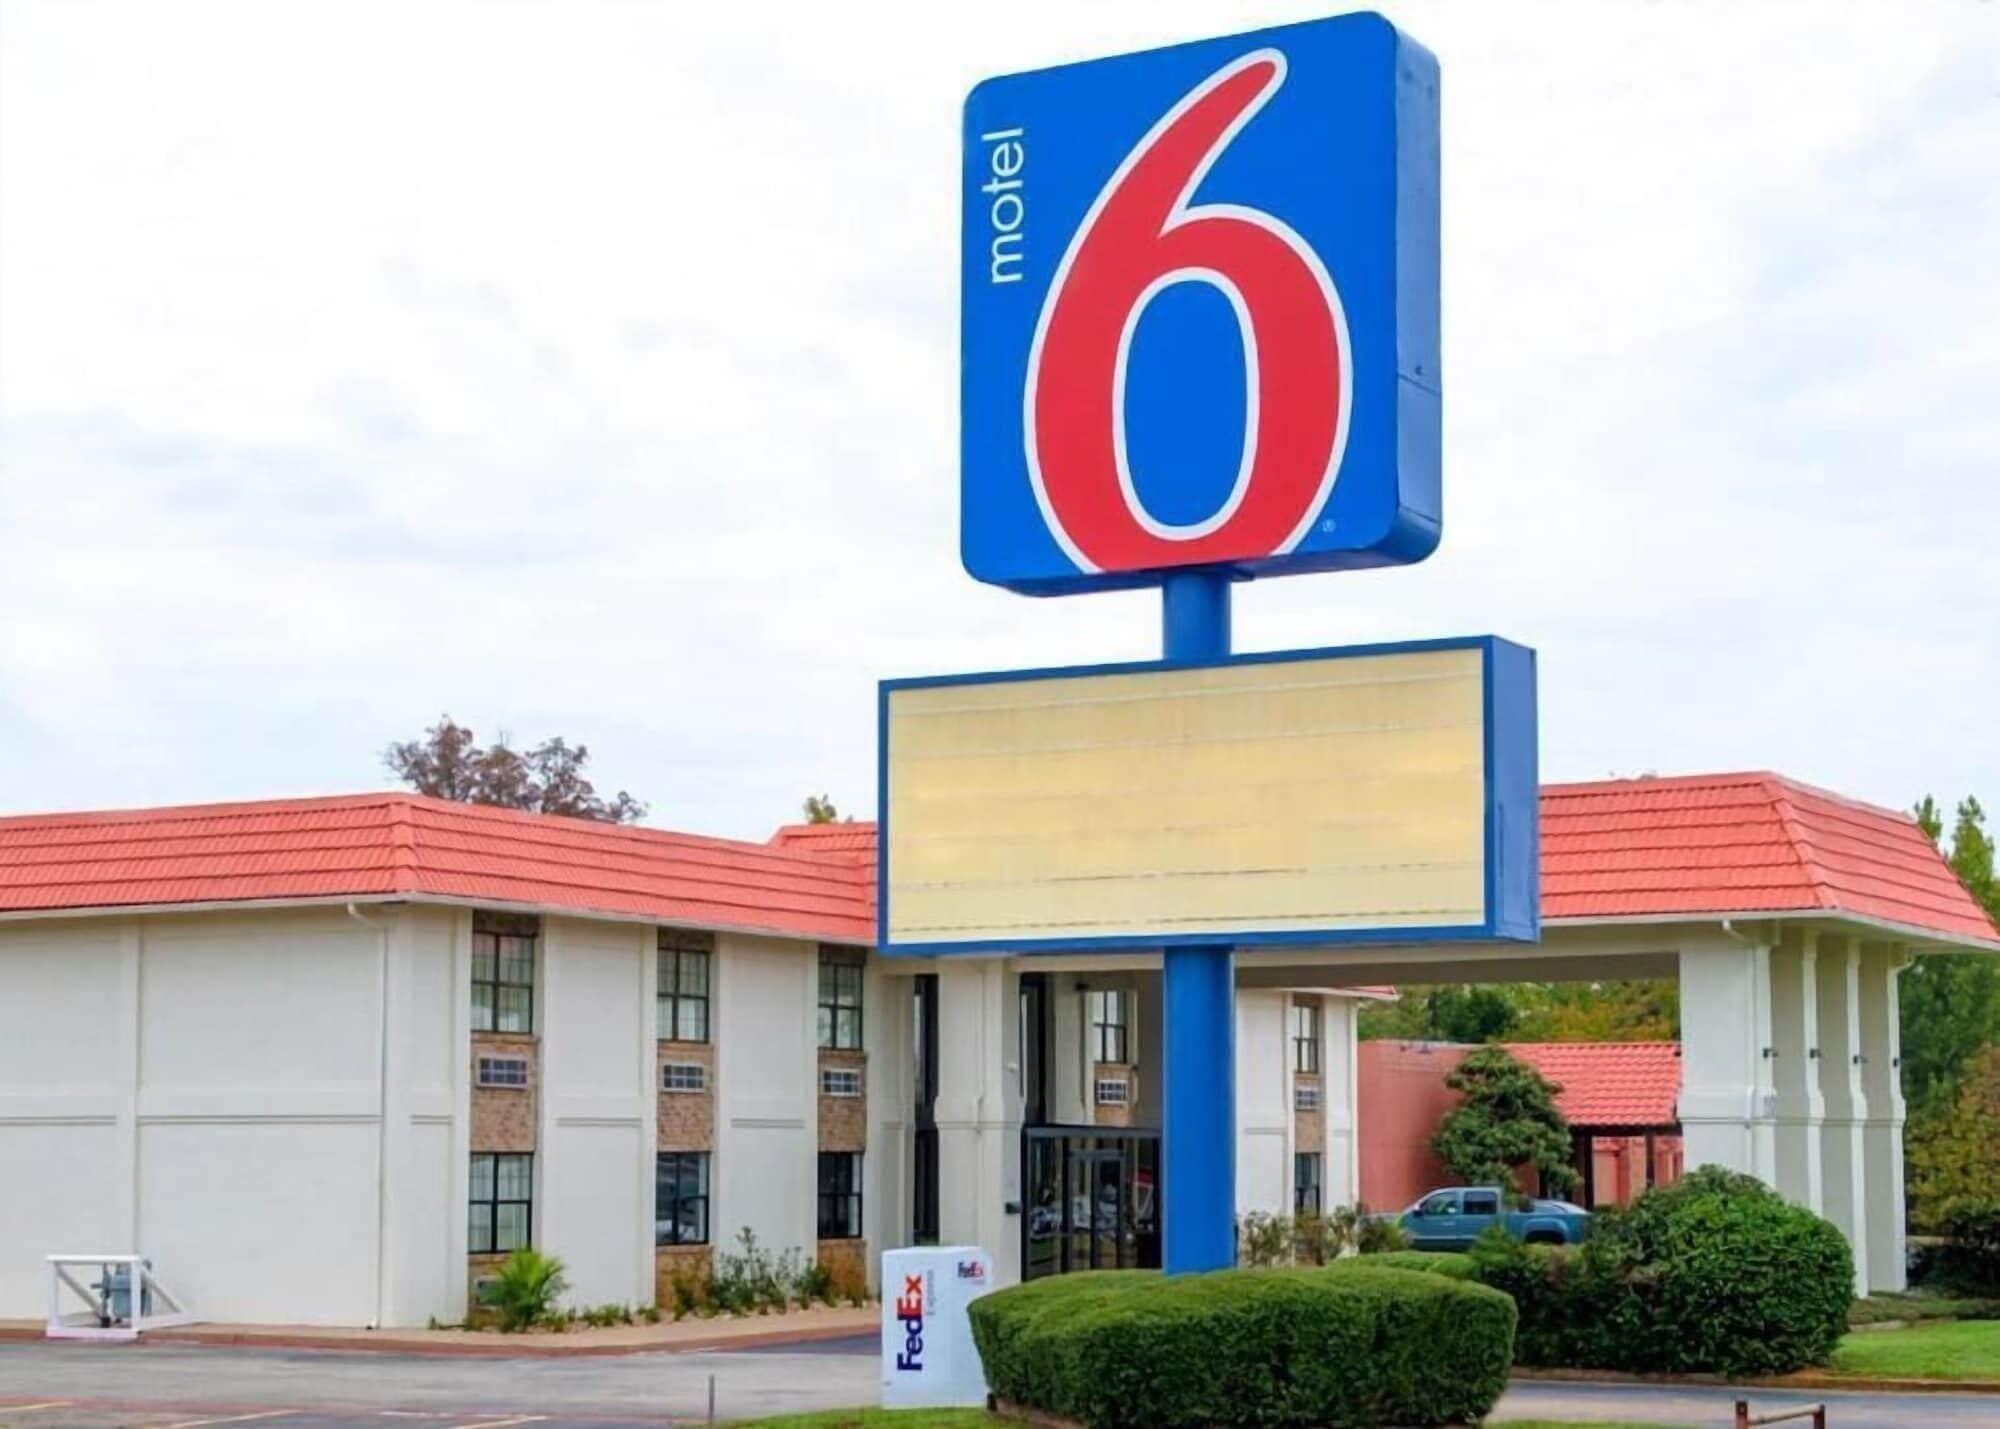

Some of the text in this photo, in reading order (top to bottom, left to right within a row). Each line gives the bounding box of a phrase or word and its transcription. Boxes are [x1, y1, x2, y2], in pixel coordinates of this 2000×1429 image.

[981, 47, 1352, 574] motel 6
[897, 1274, 923, 1371] FedEx
